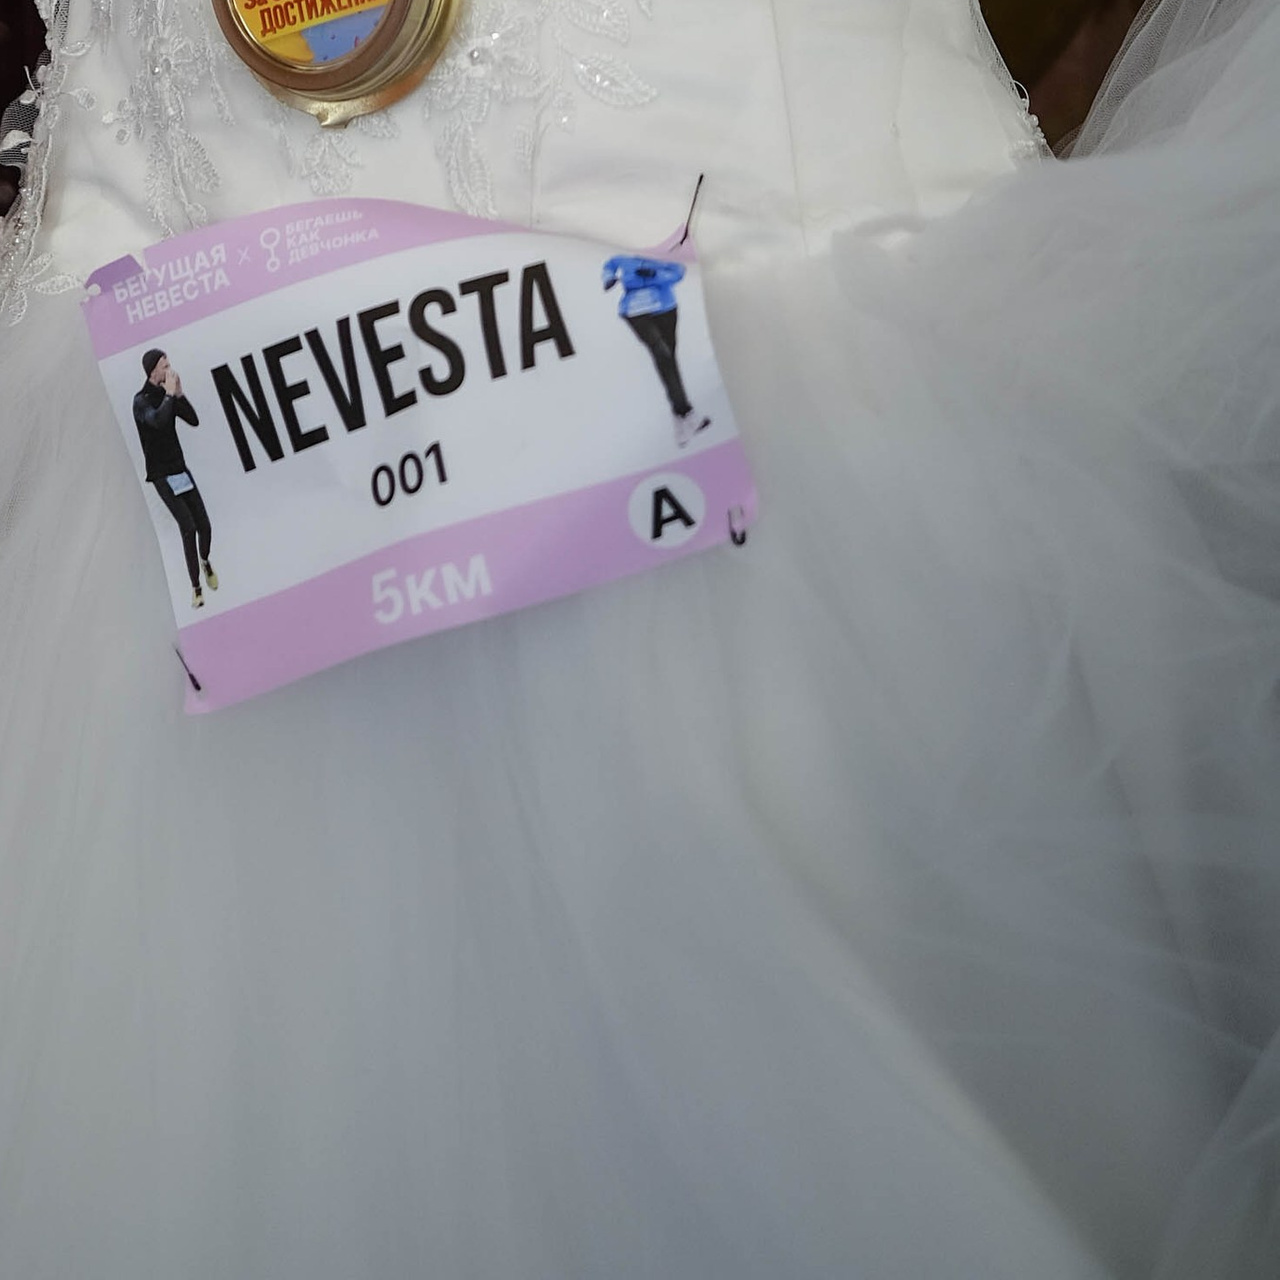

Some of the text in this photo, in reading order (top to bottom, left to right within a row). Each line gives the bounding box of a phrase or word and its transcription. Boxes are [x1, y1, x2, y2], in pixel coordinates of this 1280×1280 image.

[285, 209, 364, 236] БЕГАЕШЬ
[286, 228, 321, 250] КАК
[287, 228, 380, 265] ДЕВЧОНКА
[112, 242, 227, 305] БЕГУЩАЯ
[125, 269, 231, 326] НЕВЕСТА
[210, 262, 575, 472] NEVESTA
[371, 442, 449, 507] 001
[649, 488, 695, 540] A
